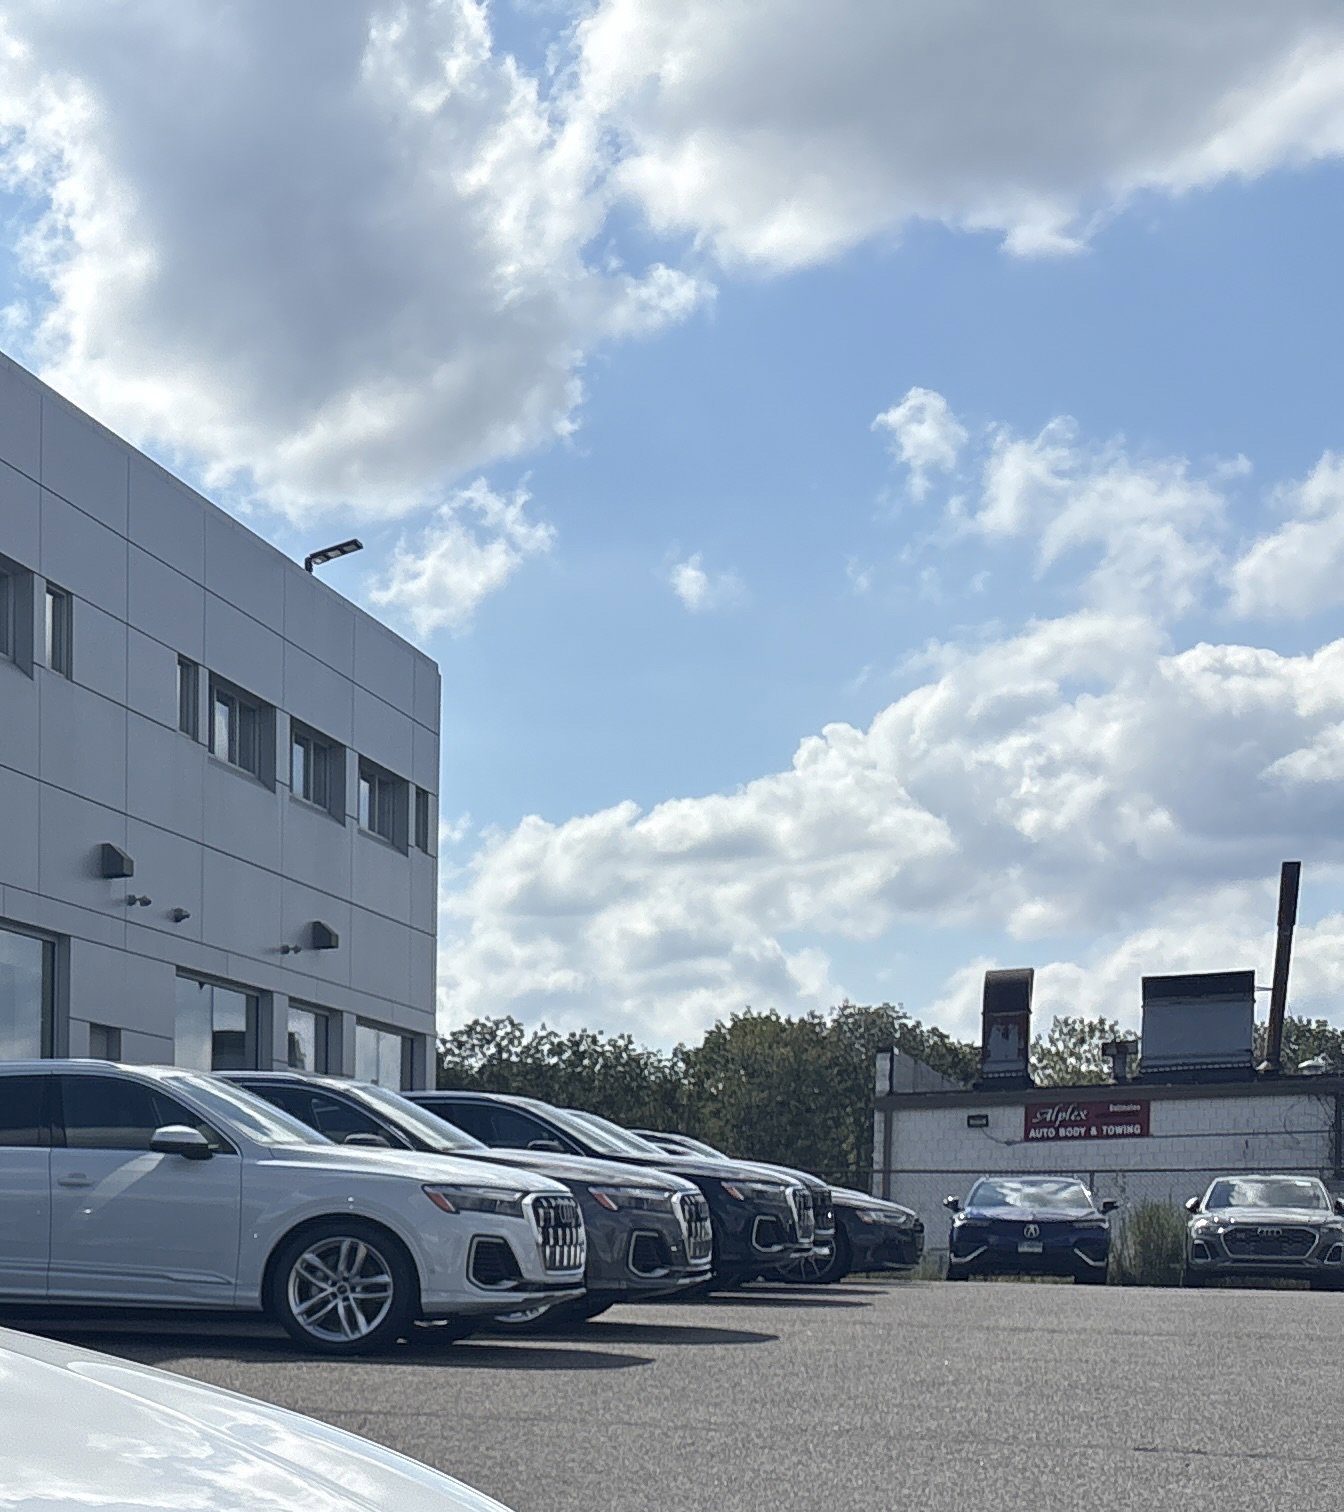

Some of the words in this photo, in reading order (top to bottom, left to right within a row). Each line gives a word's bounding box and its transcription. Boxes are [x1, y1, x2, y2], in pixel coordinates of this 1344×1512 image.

[1029, 1127, 1056, 1139] AUTO
[1058, 1126, 1087, 1138] BODY
[1090, 1126, 1098, 1136] &
[1101, 1124, 1142, 1136] TOWING
